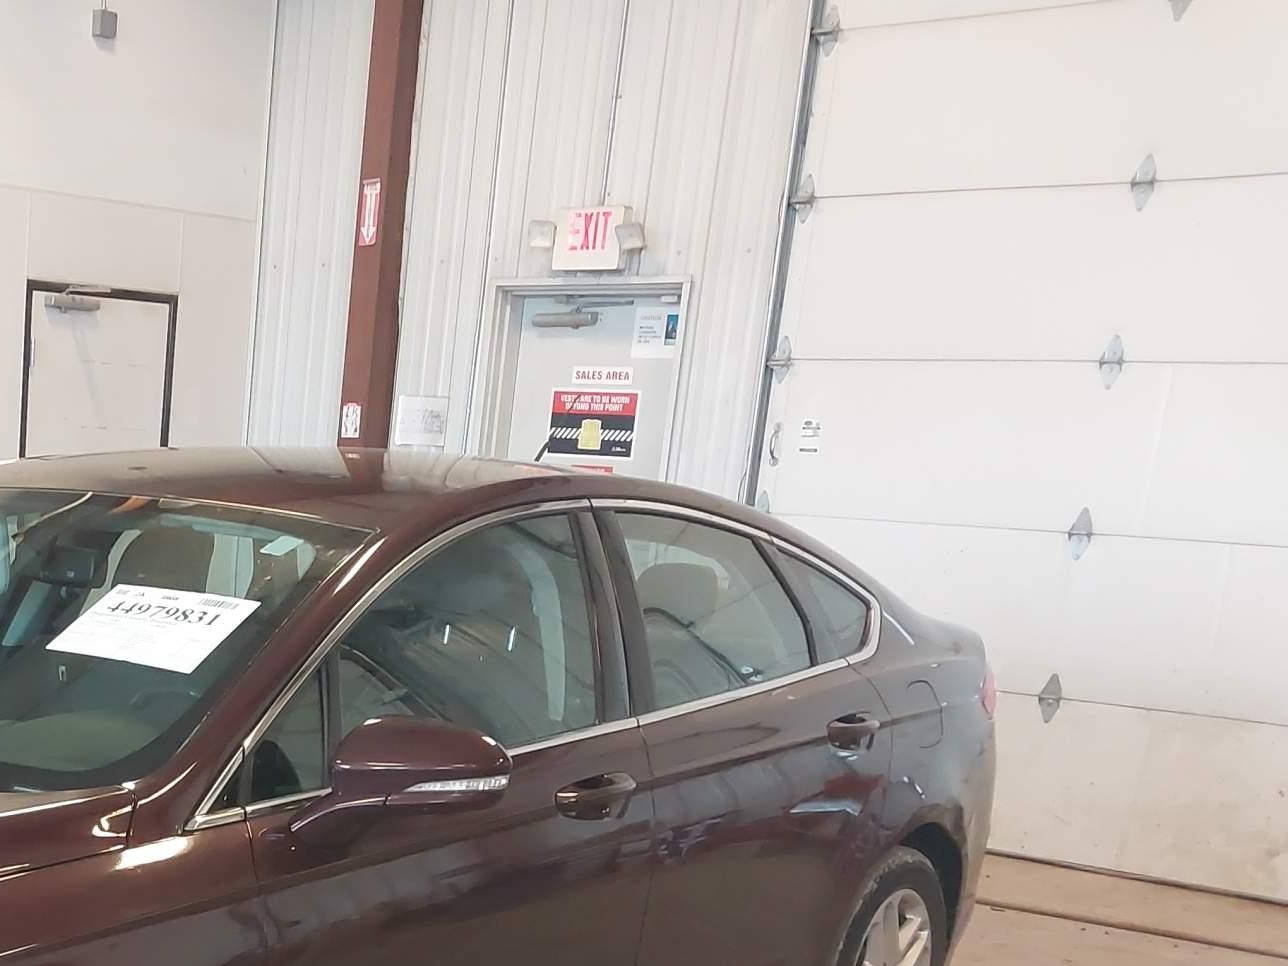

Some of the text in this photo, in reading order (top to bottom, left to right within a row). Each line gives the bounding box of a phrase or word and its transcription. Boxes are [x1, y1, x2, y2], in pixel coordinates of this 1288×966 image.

[568, 211, 613, 250] EXIT
[575, 370, 630, 380] SALES AREA
[593, 395, 601, 403] TO
[107, 600, 221, 626] 44979831
